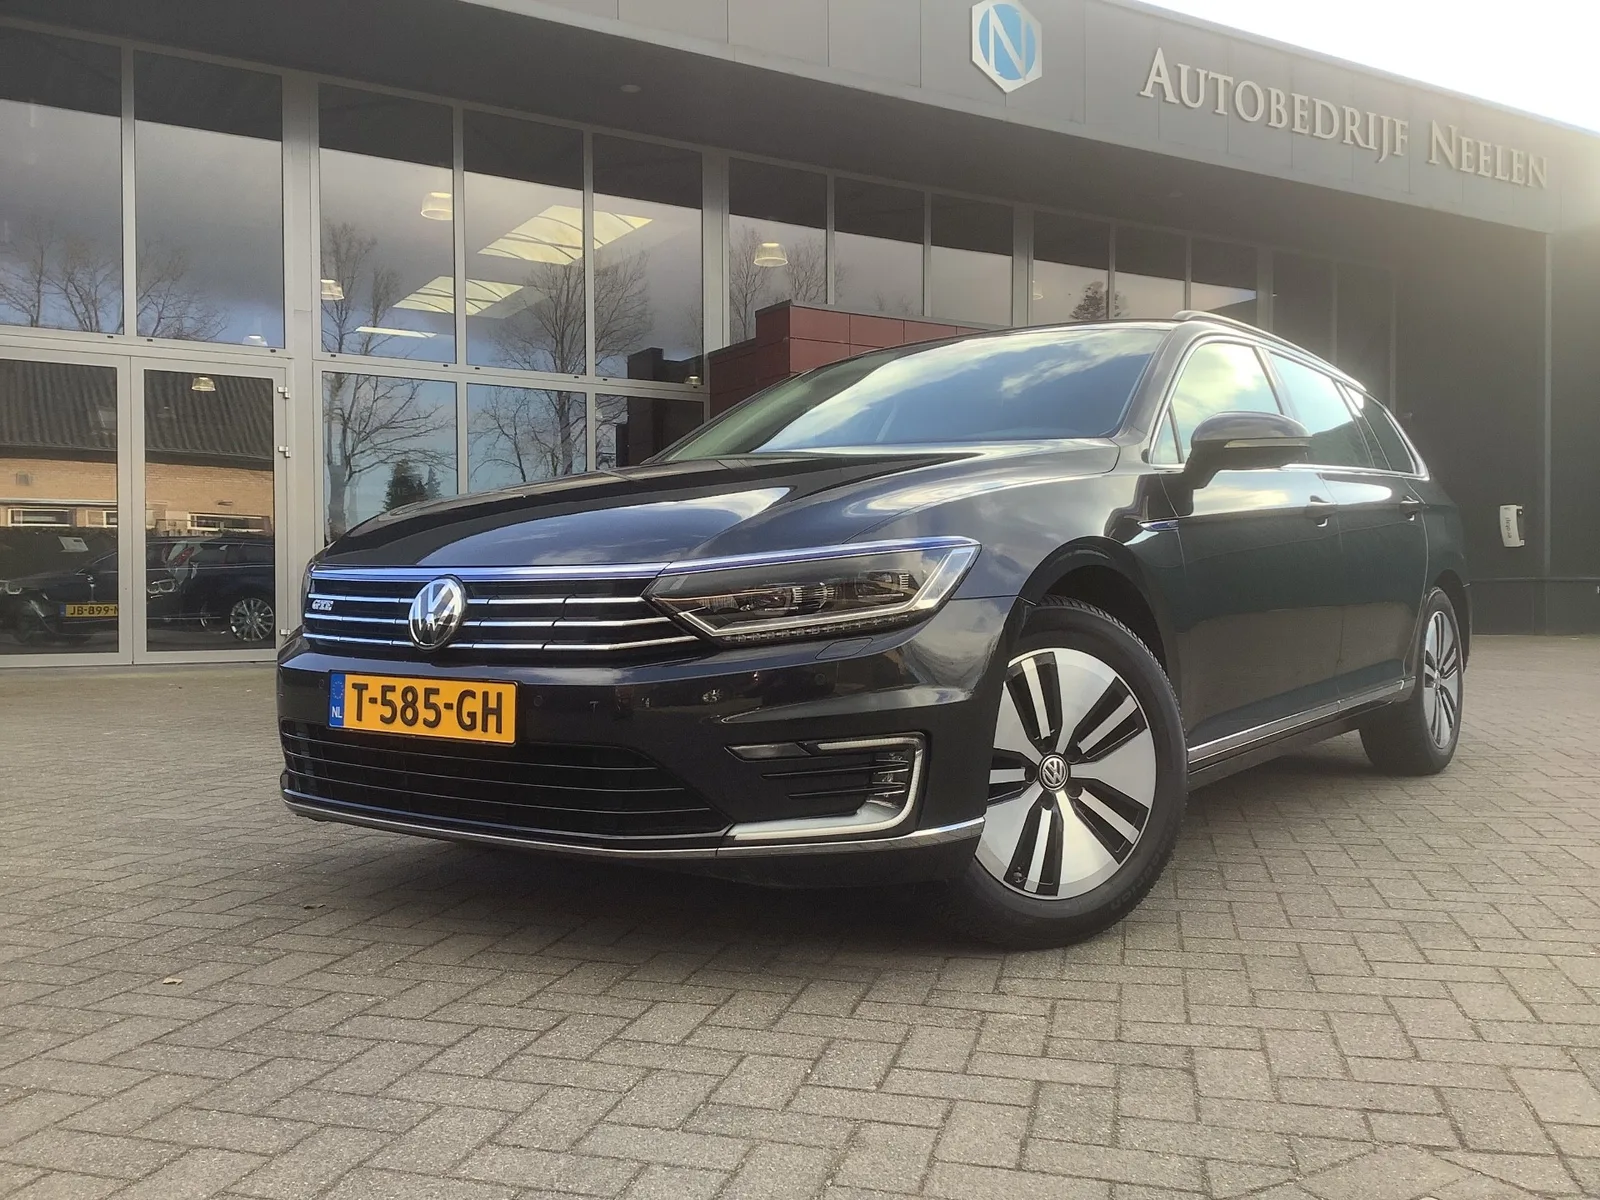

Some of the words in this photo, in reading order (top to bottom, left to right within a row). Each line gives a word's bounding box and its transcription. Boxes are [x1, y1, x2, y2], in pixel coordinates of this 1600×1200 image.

[1139, 47, 1409, 163] AUTOBEDRIJF
[1428, 119, 1549, 190] NEELEN
[331, 705, 343, 719] NL
[351, 682, 503, 734] T-585-GH
